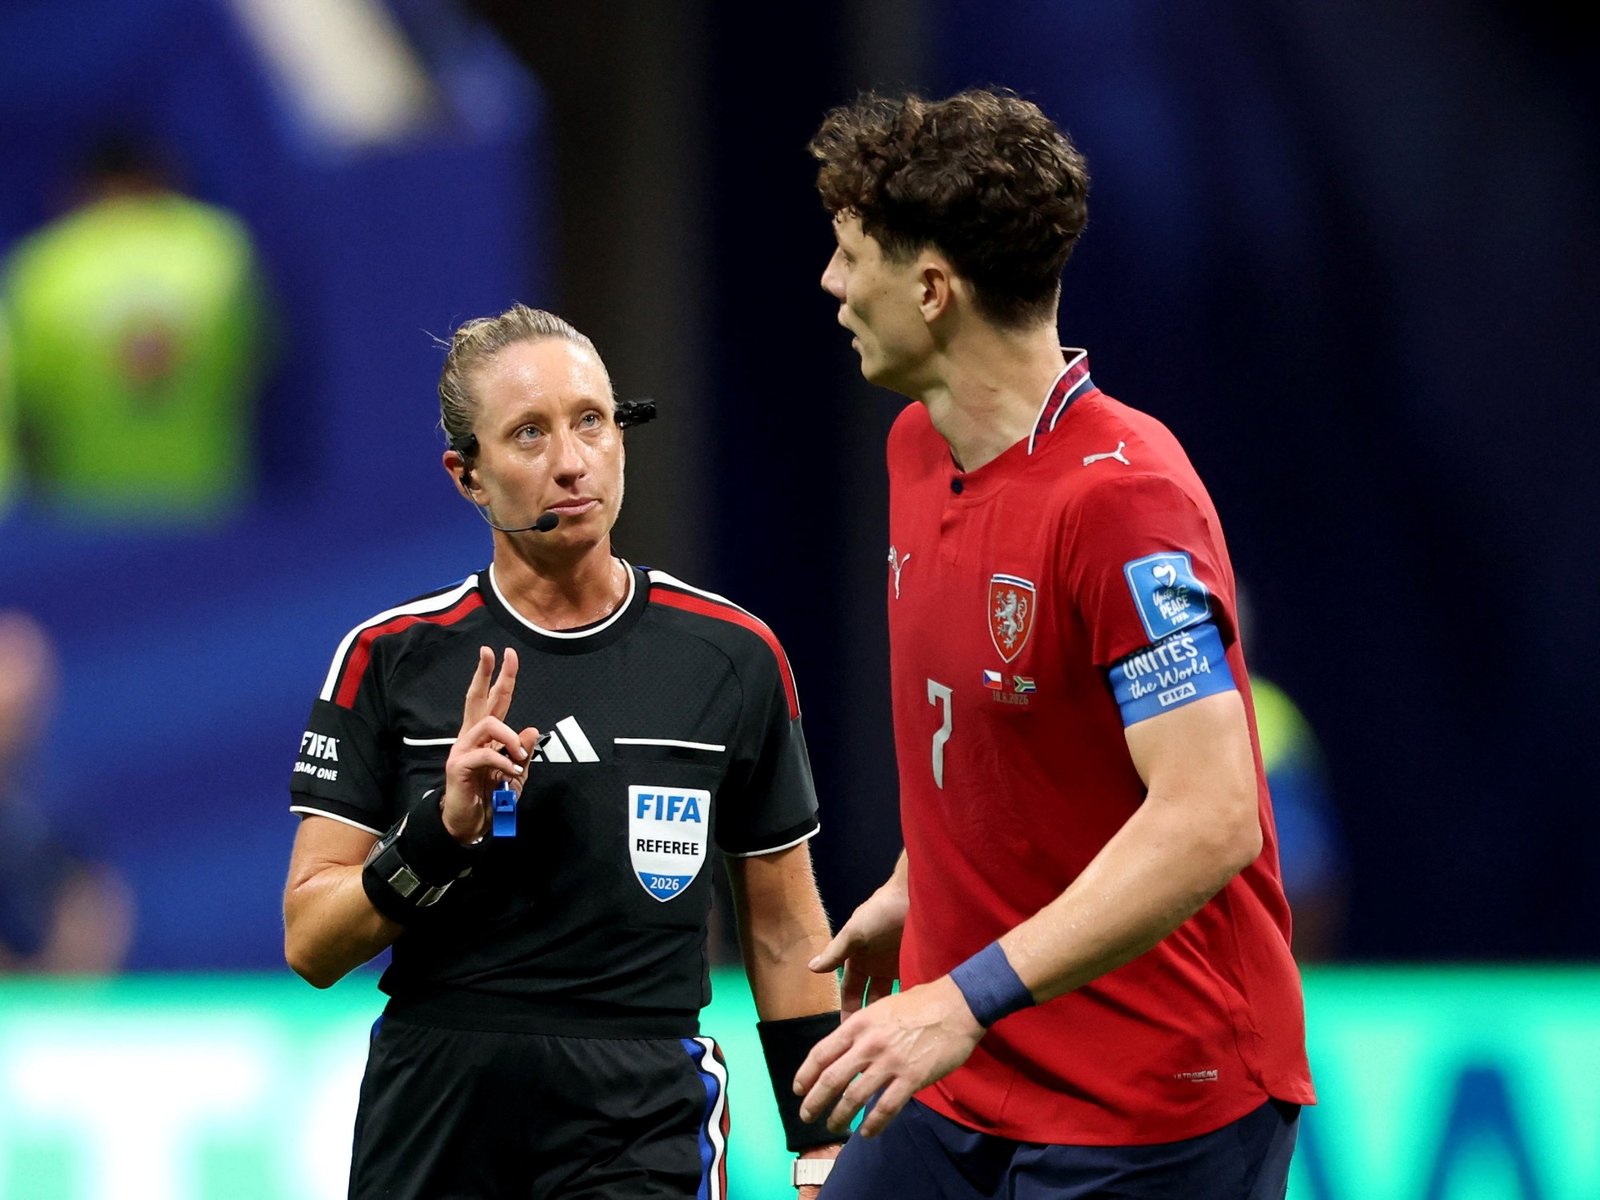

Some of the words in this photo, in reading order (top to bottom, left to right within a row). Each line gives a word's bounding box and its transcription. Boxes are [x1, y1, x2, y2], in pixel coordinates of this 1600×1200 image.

[1159, 595, 1191, 620] PEACE
[1171, 611, 1190, 626] FIFA
[1122, 636, 1199, 680] UNITES
[1128, 680, 1157, 699] the
[1155, 656, 1211, 688] World
[1162, 685, 1193, 702] FIFA
[299, 730, 339, 762] FIFA
[927, 678, 954, 790] 7
[293, 761, 318, 776] EAM
[316, 767, 338, 781] ONE
[636, 793, 702, 823] FIFA
[636, 838, 699, 856] REFEREE
[650, 876, 680, 890] 2026
